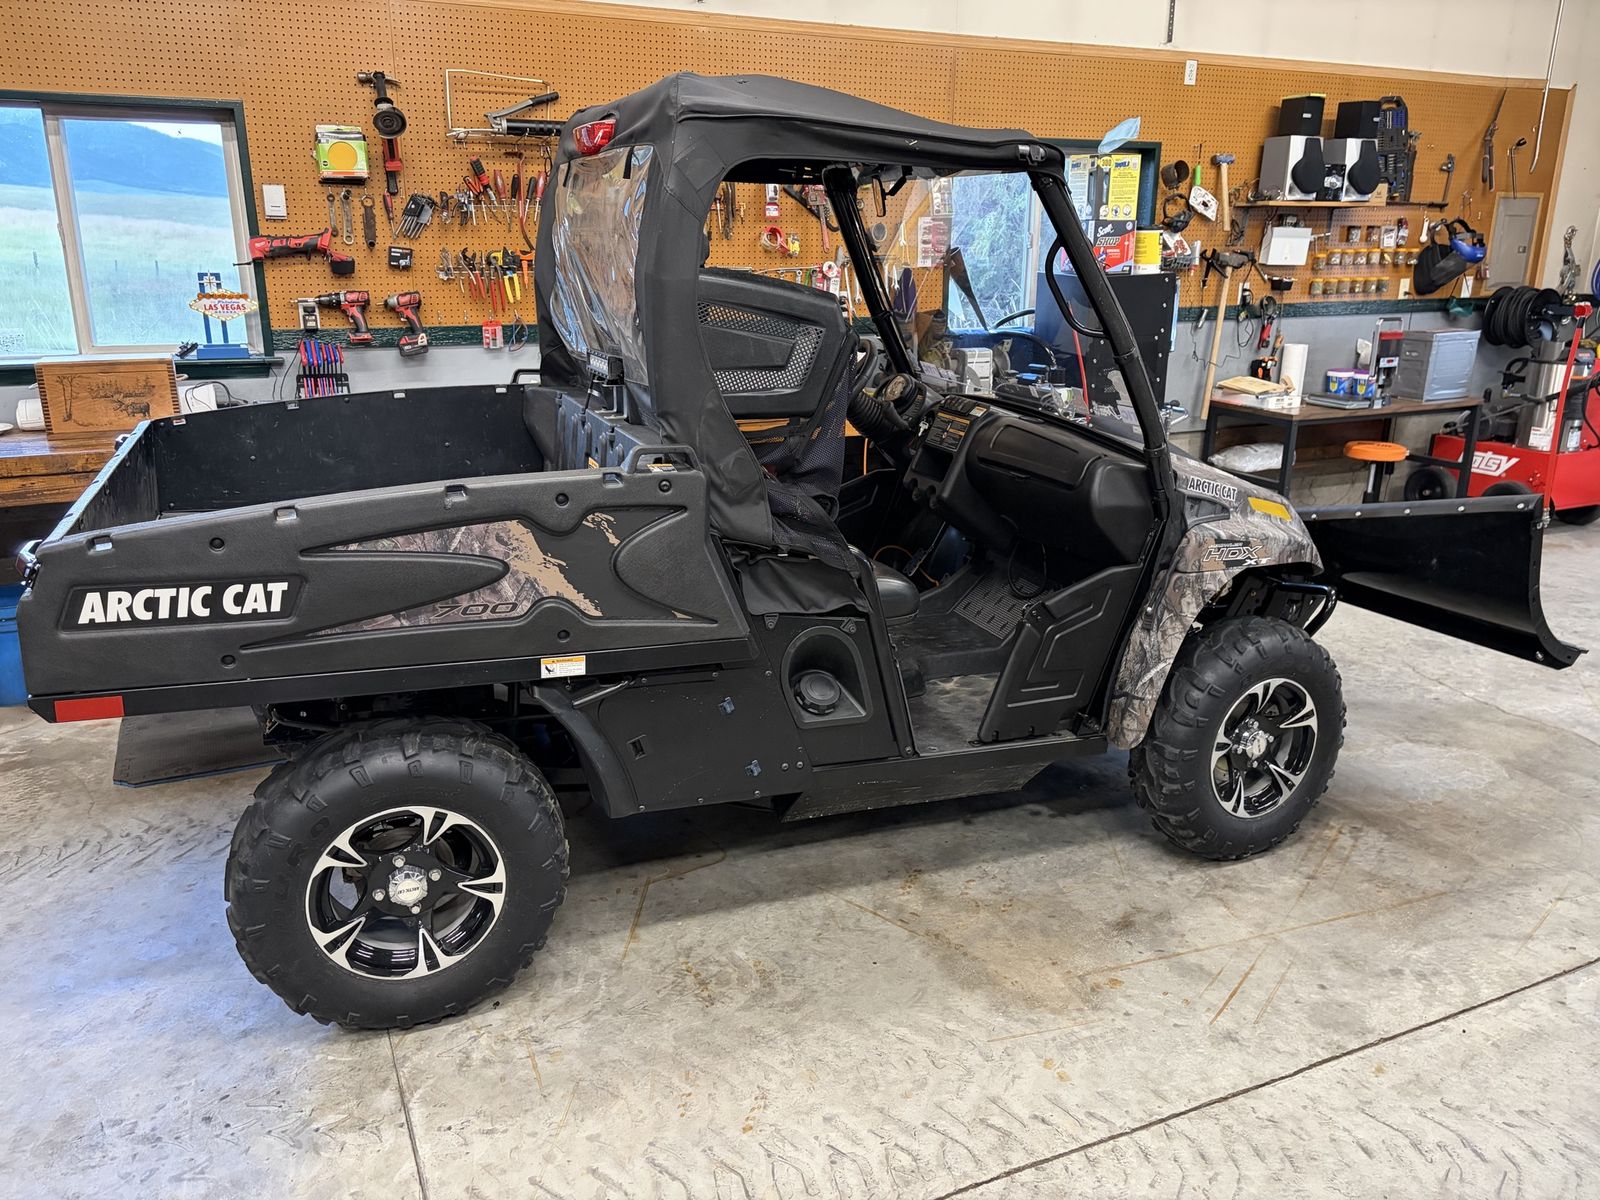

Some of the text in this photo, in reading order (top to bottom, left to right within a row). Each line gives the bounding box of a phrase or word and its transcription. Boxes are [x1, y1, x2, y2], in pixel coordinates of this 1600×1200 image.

[1097, 224, 1114, 237] Scott
[1096, 236, 1121, 247] SHOP
[204, 303, 247, 311] LAS VEGAS
[1458, 451, 1520, 477] otsy
[1187, 477, 1238, 501] ARCTIC CAT
[1203, 545, 1263, 562] HDX
[1242, 557, 1271, 566] XT
[78, 582, 288, 624] ARCTIC CAT
[429, 602, 520, 619] 700
